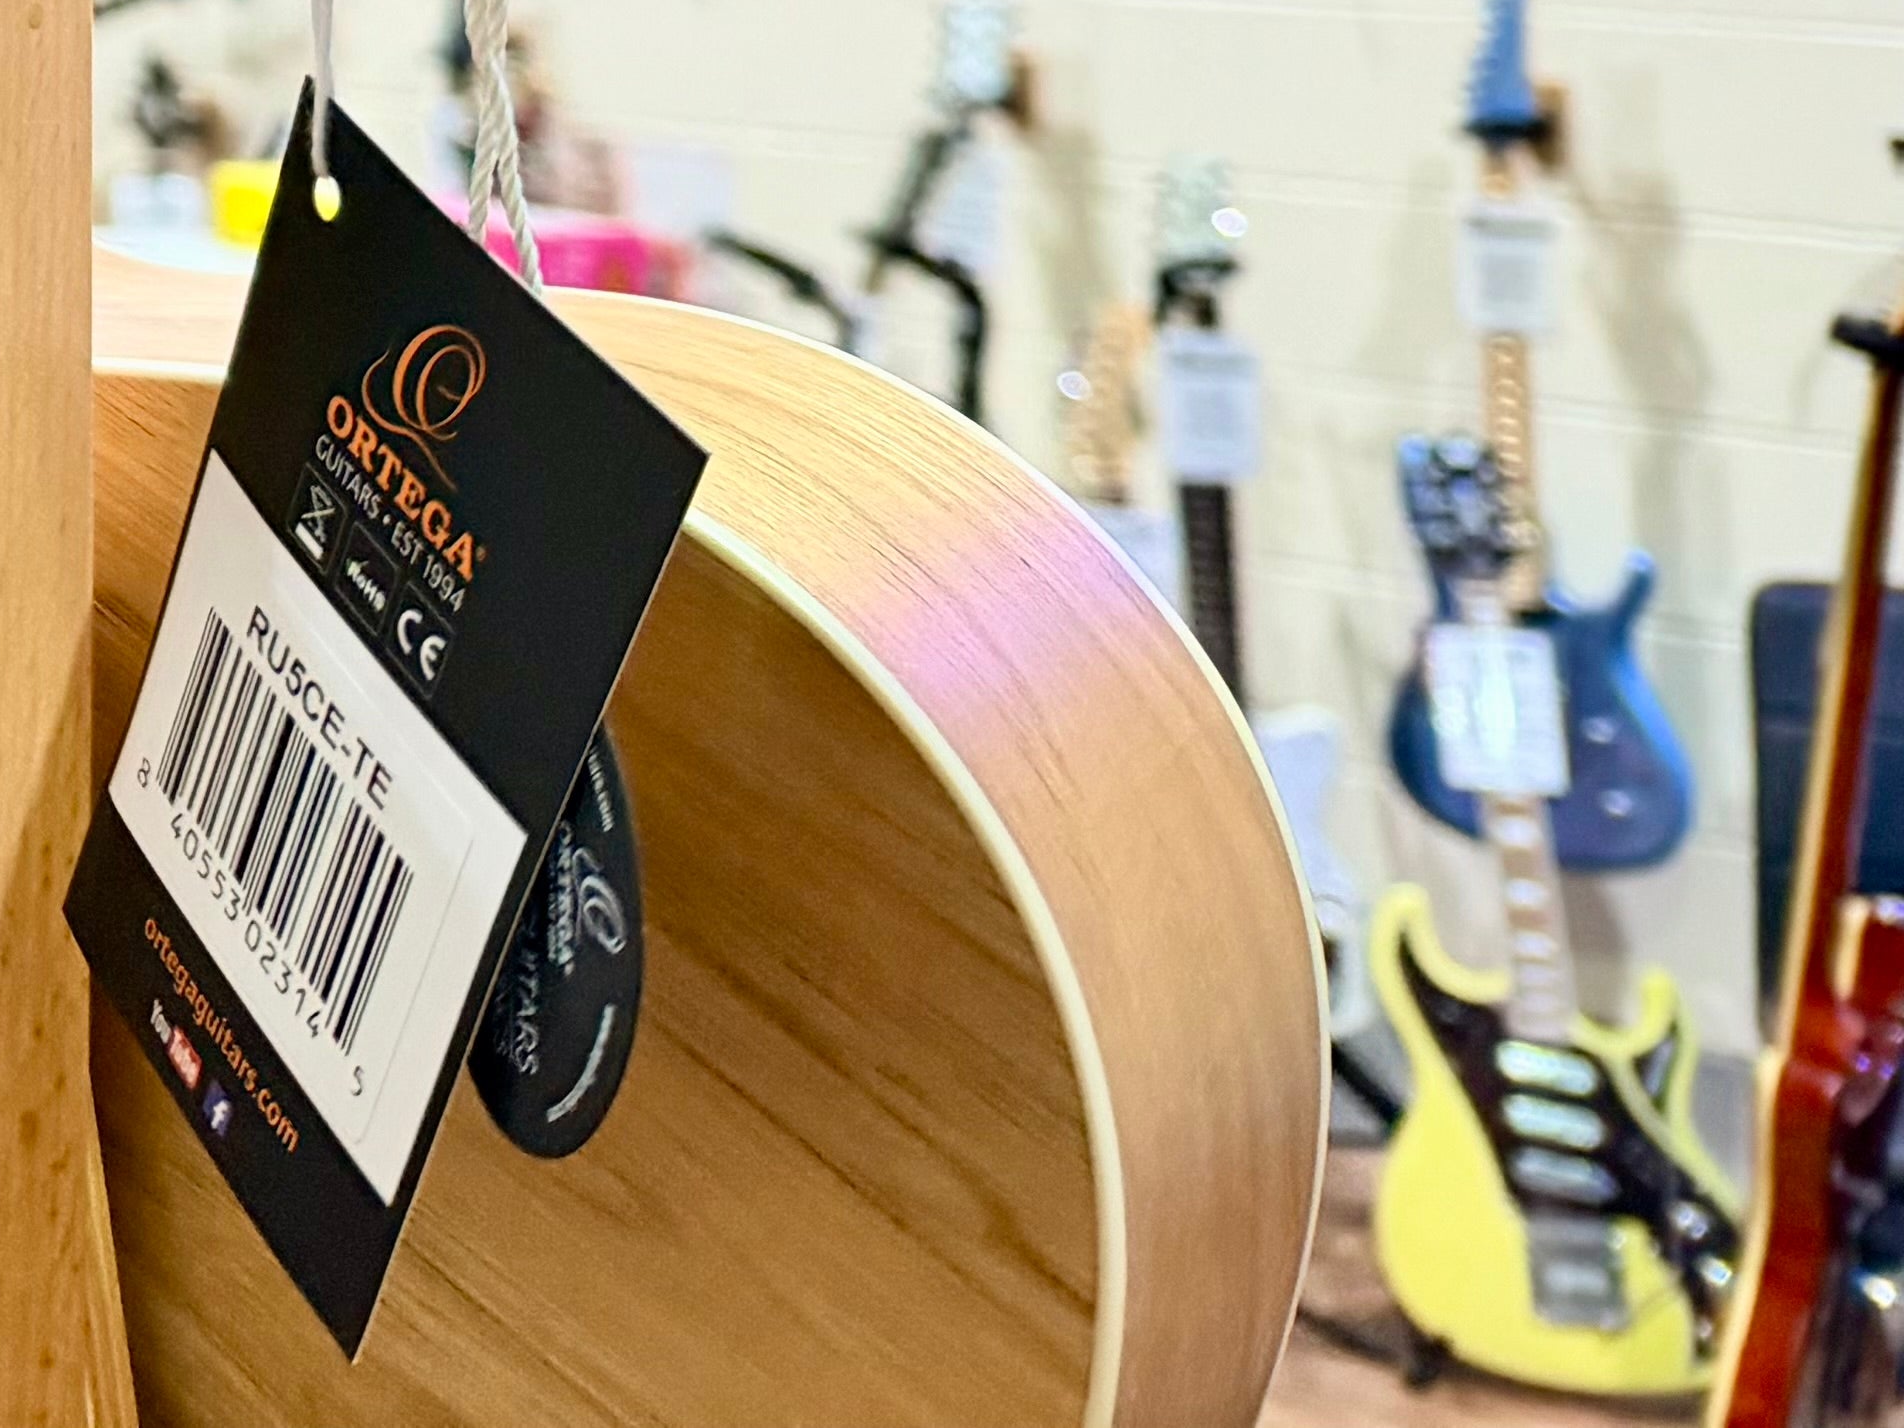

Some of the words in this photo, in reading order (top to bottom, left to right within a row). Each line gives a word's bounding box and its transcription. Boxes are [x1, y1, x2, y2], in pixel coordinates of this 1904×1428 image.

[315, 434, 383, 527] GUITARS
[390, 520, 426, 567] EST
[422, 553, 468, 614] 1994
[246, 604, 395, 813] RU5CE-TE
[137, 756, 152, 789] 8
[169, 811, 243, 922] 40553
[243, 918, 323, 1039] 02314
[350, 1065, 365, 1097] 5
[145, 918, 300, 1154] ortegaguitars.com
